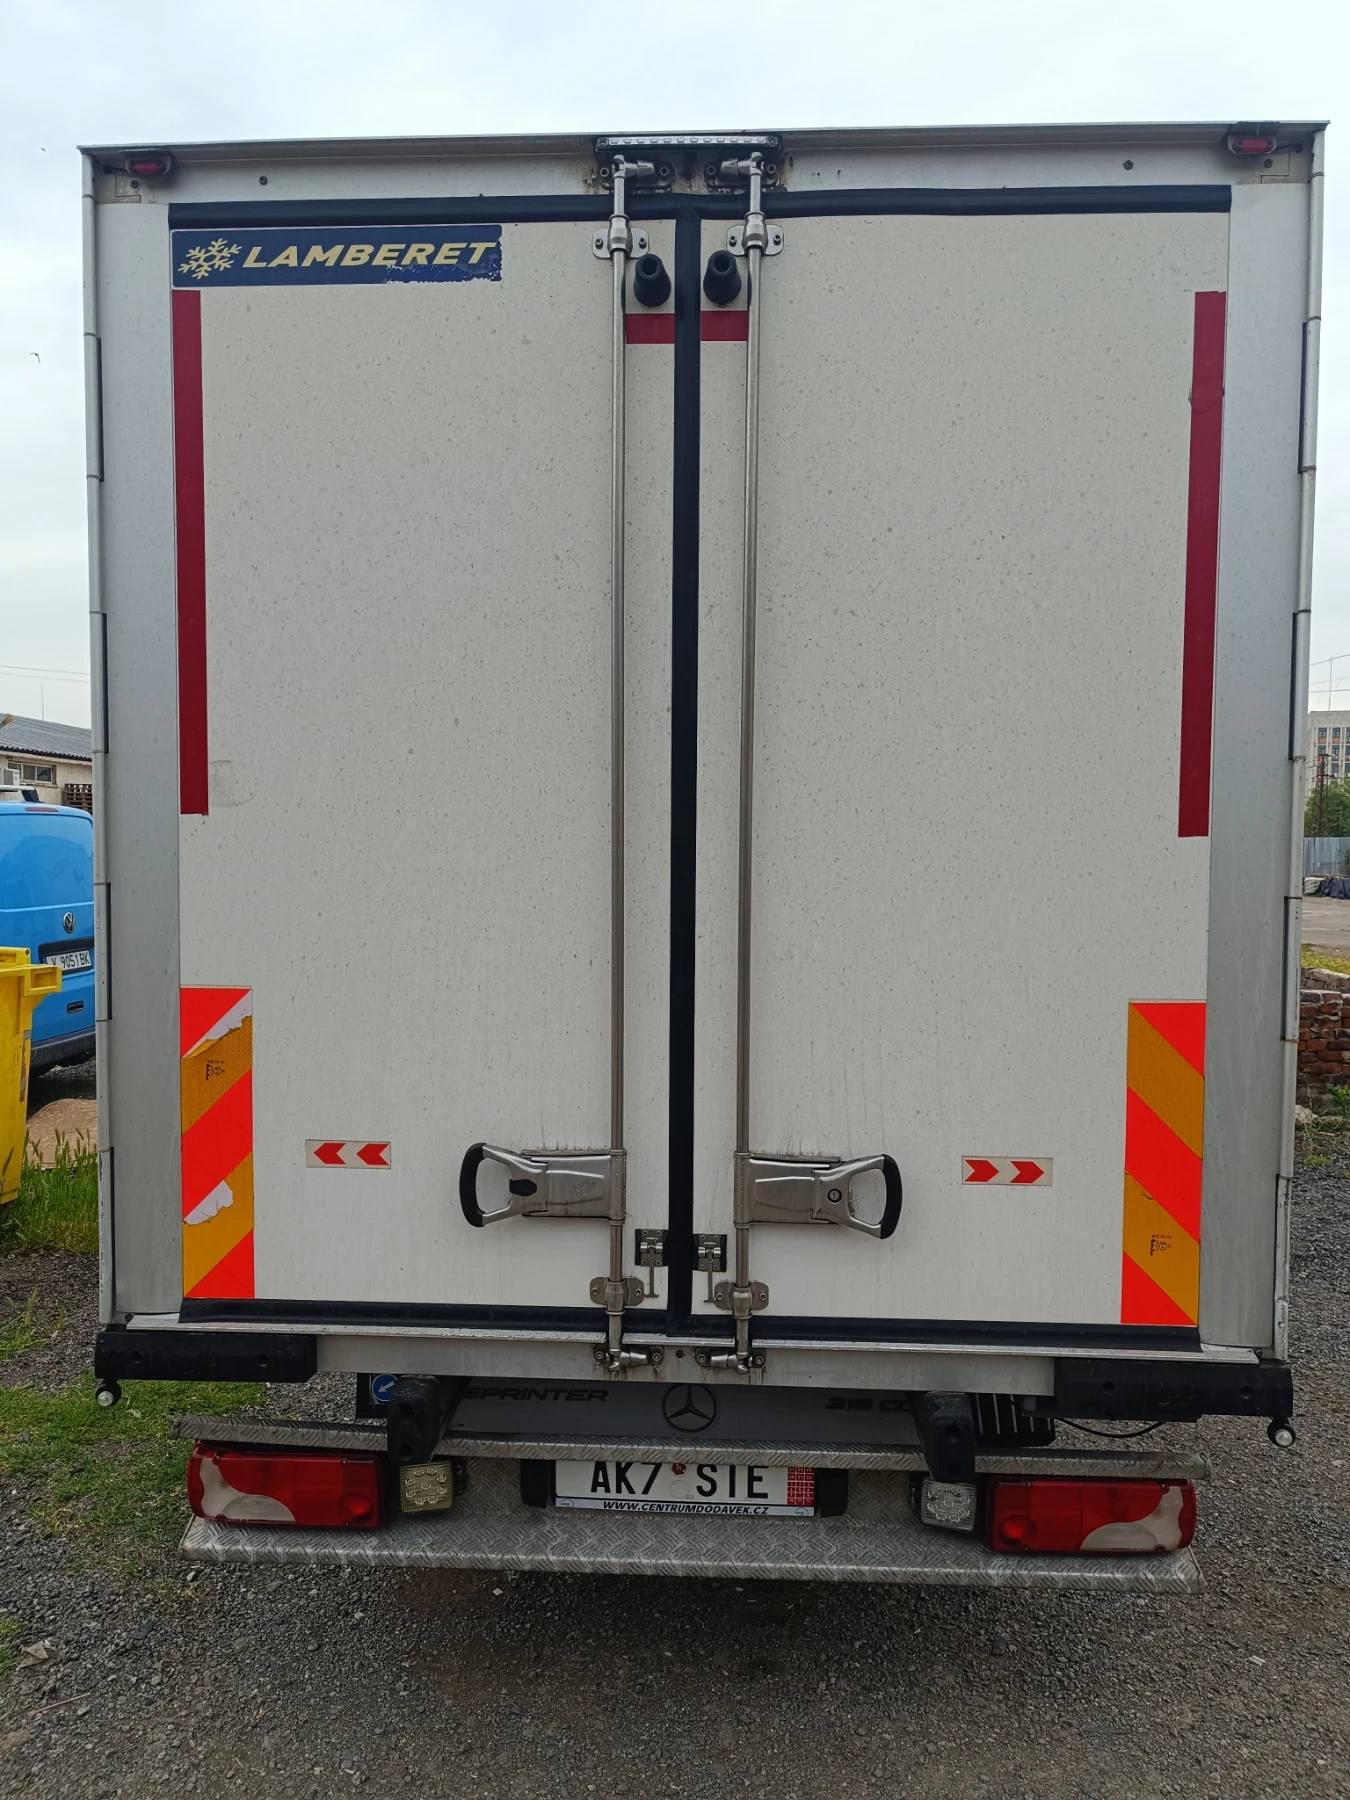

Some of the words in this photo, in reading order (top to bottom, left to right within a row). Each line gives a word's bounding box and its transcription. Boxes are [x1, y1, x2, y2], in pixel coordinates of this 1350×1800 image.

[243, 242, 496, 268] LAMBERET
[60, 954, 79, 969] 9051
[78, 952, 90, 966] BK
[462, 1386, 609, 1402] SPRINTER
[591, 1461, 662, 1495] AK7
[603, 1501, 769, 1515] WWW.CENTRUMDODAVEK.CZ
